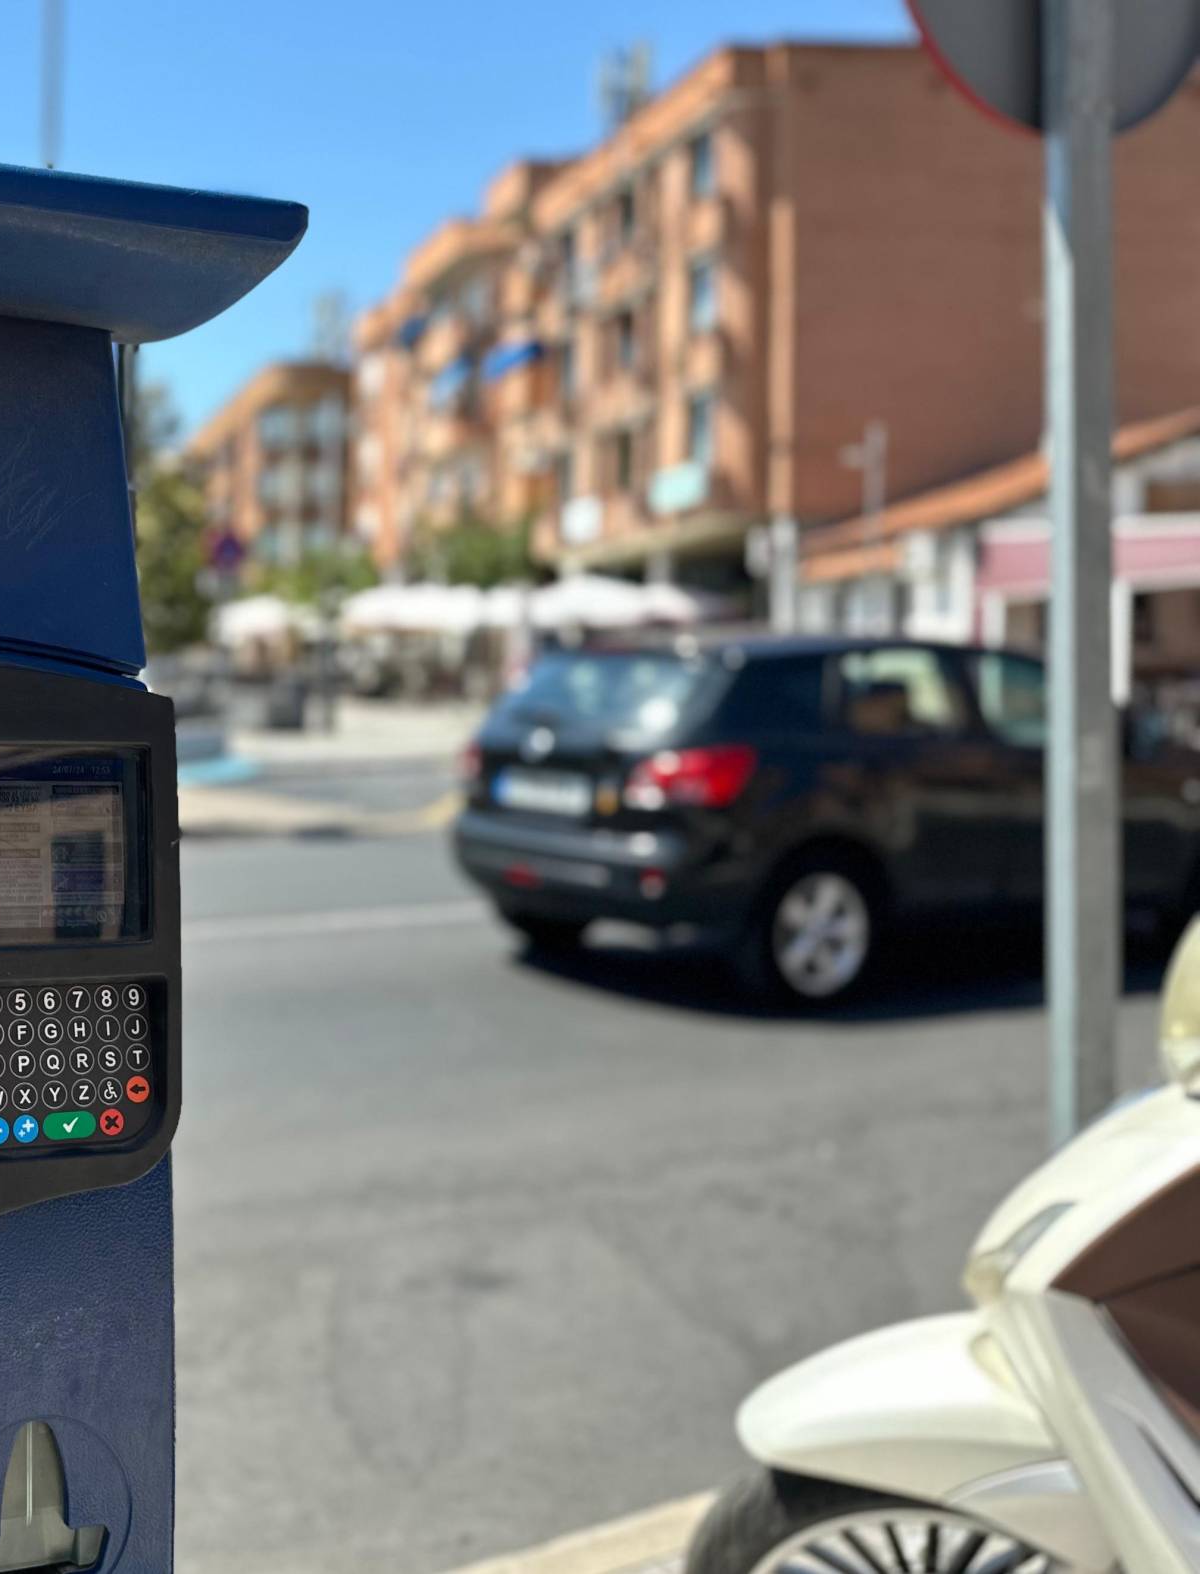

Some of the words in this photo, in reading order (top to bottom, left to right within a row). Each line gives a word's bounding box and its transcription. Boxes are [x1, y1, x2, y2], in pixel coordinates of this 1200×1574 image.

[15, 993, 26, 1011] 5
[44, 992, 55, 1009] 6
[72, 991, 83, 1008] 7
[101, 990, 112, 1007] 8
[129, 989, 139, 1006] 9
[17, 1025, 27, 1040] F
[44, 1023, 57, 1039] G
[74, 1022, 85, 1037] H
[18, 1056, 30, 1072] P
[47, 1054, 60, 1070] Q
[77, 1053, 88, 1068] R
[105, 1051, 116, 1067] S
[133, 1050, 142, 1064] T
[19, 1089, 31, 1104] X
[49, 1087, 60, 1102] Y
[79, 1085, 89, 1100] Z
